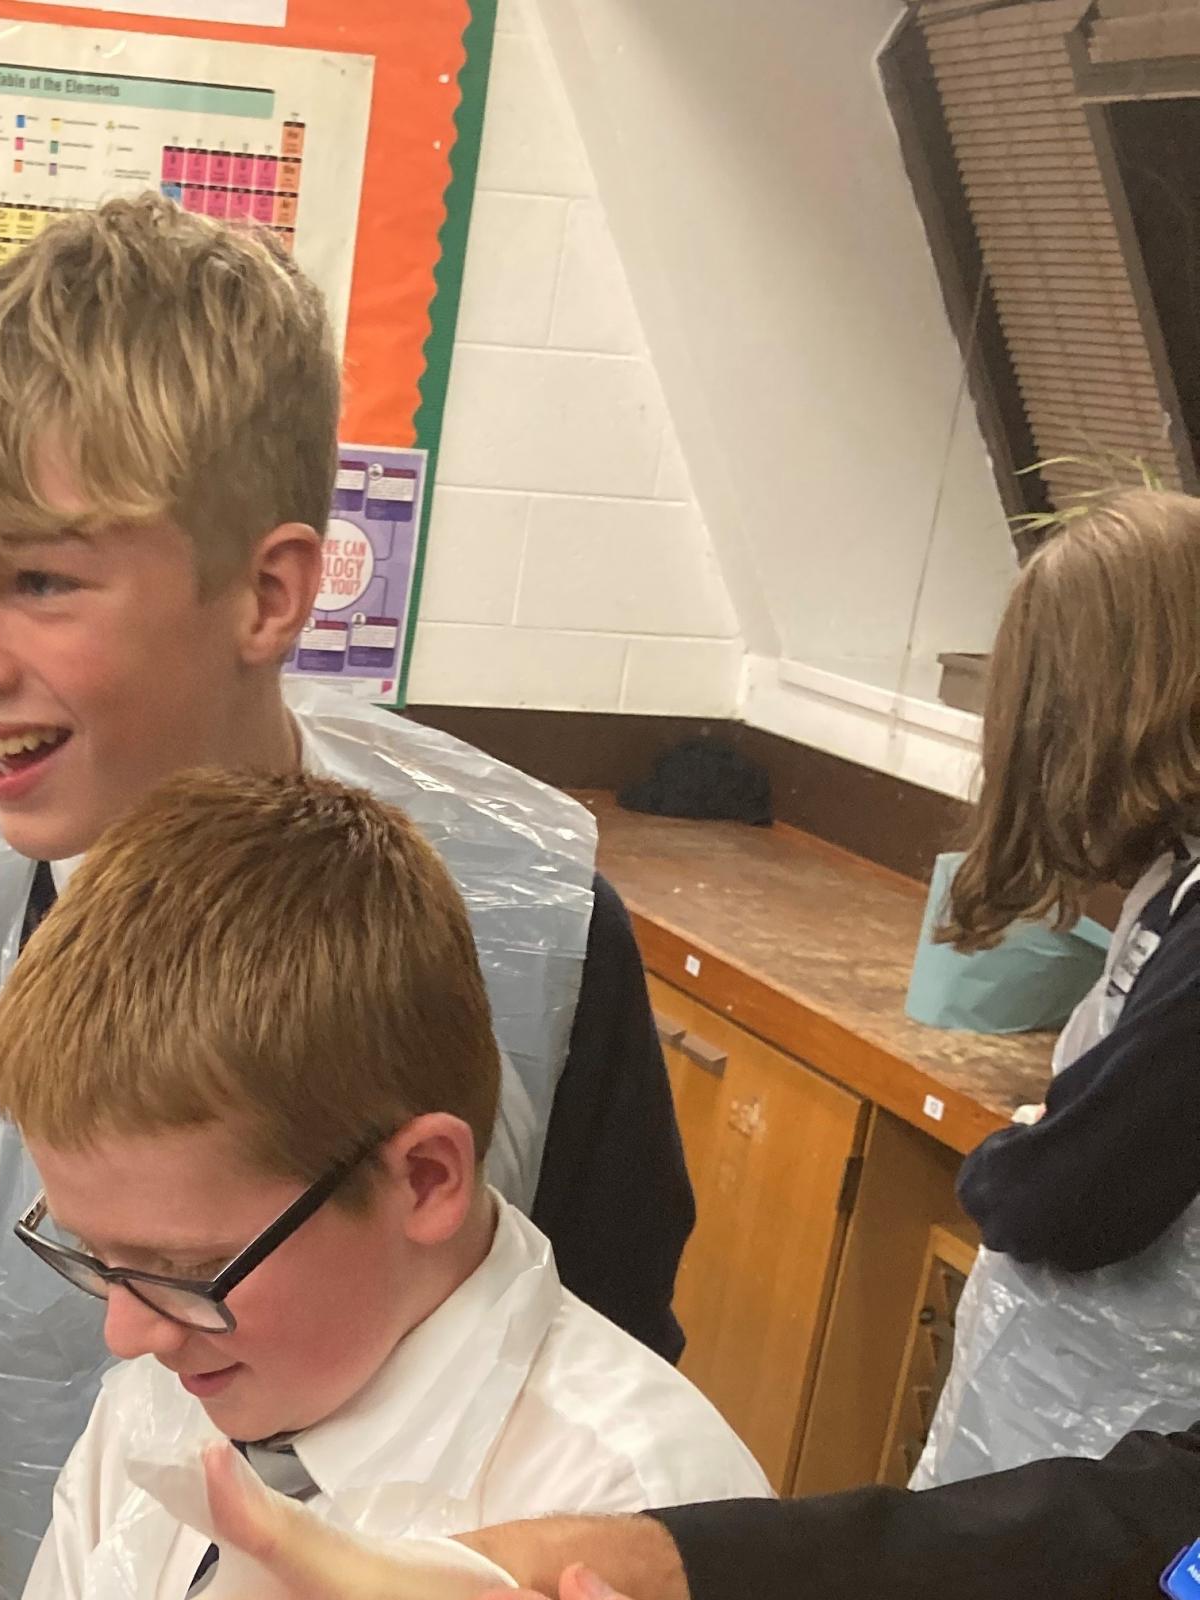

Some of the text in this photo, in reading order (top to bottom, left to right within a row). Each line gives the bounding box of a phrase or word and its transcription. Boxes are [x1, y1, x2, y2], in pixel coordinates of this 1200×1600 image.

[29, 76, 41, 89] of
[43, 77, 61, 92] the
[65, 79, 120, 97] Elements
[344, 540, 366, 557] CAN
[330, 580, 361, 596] YOU?
